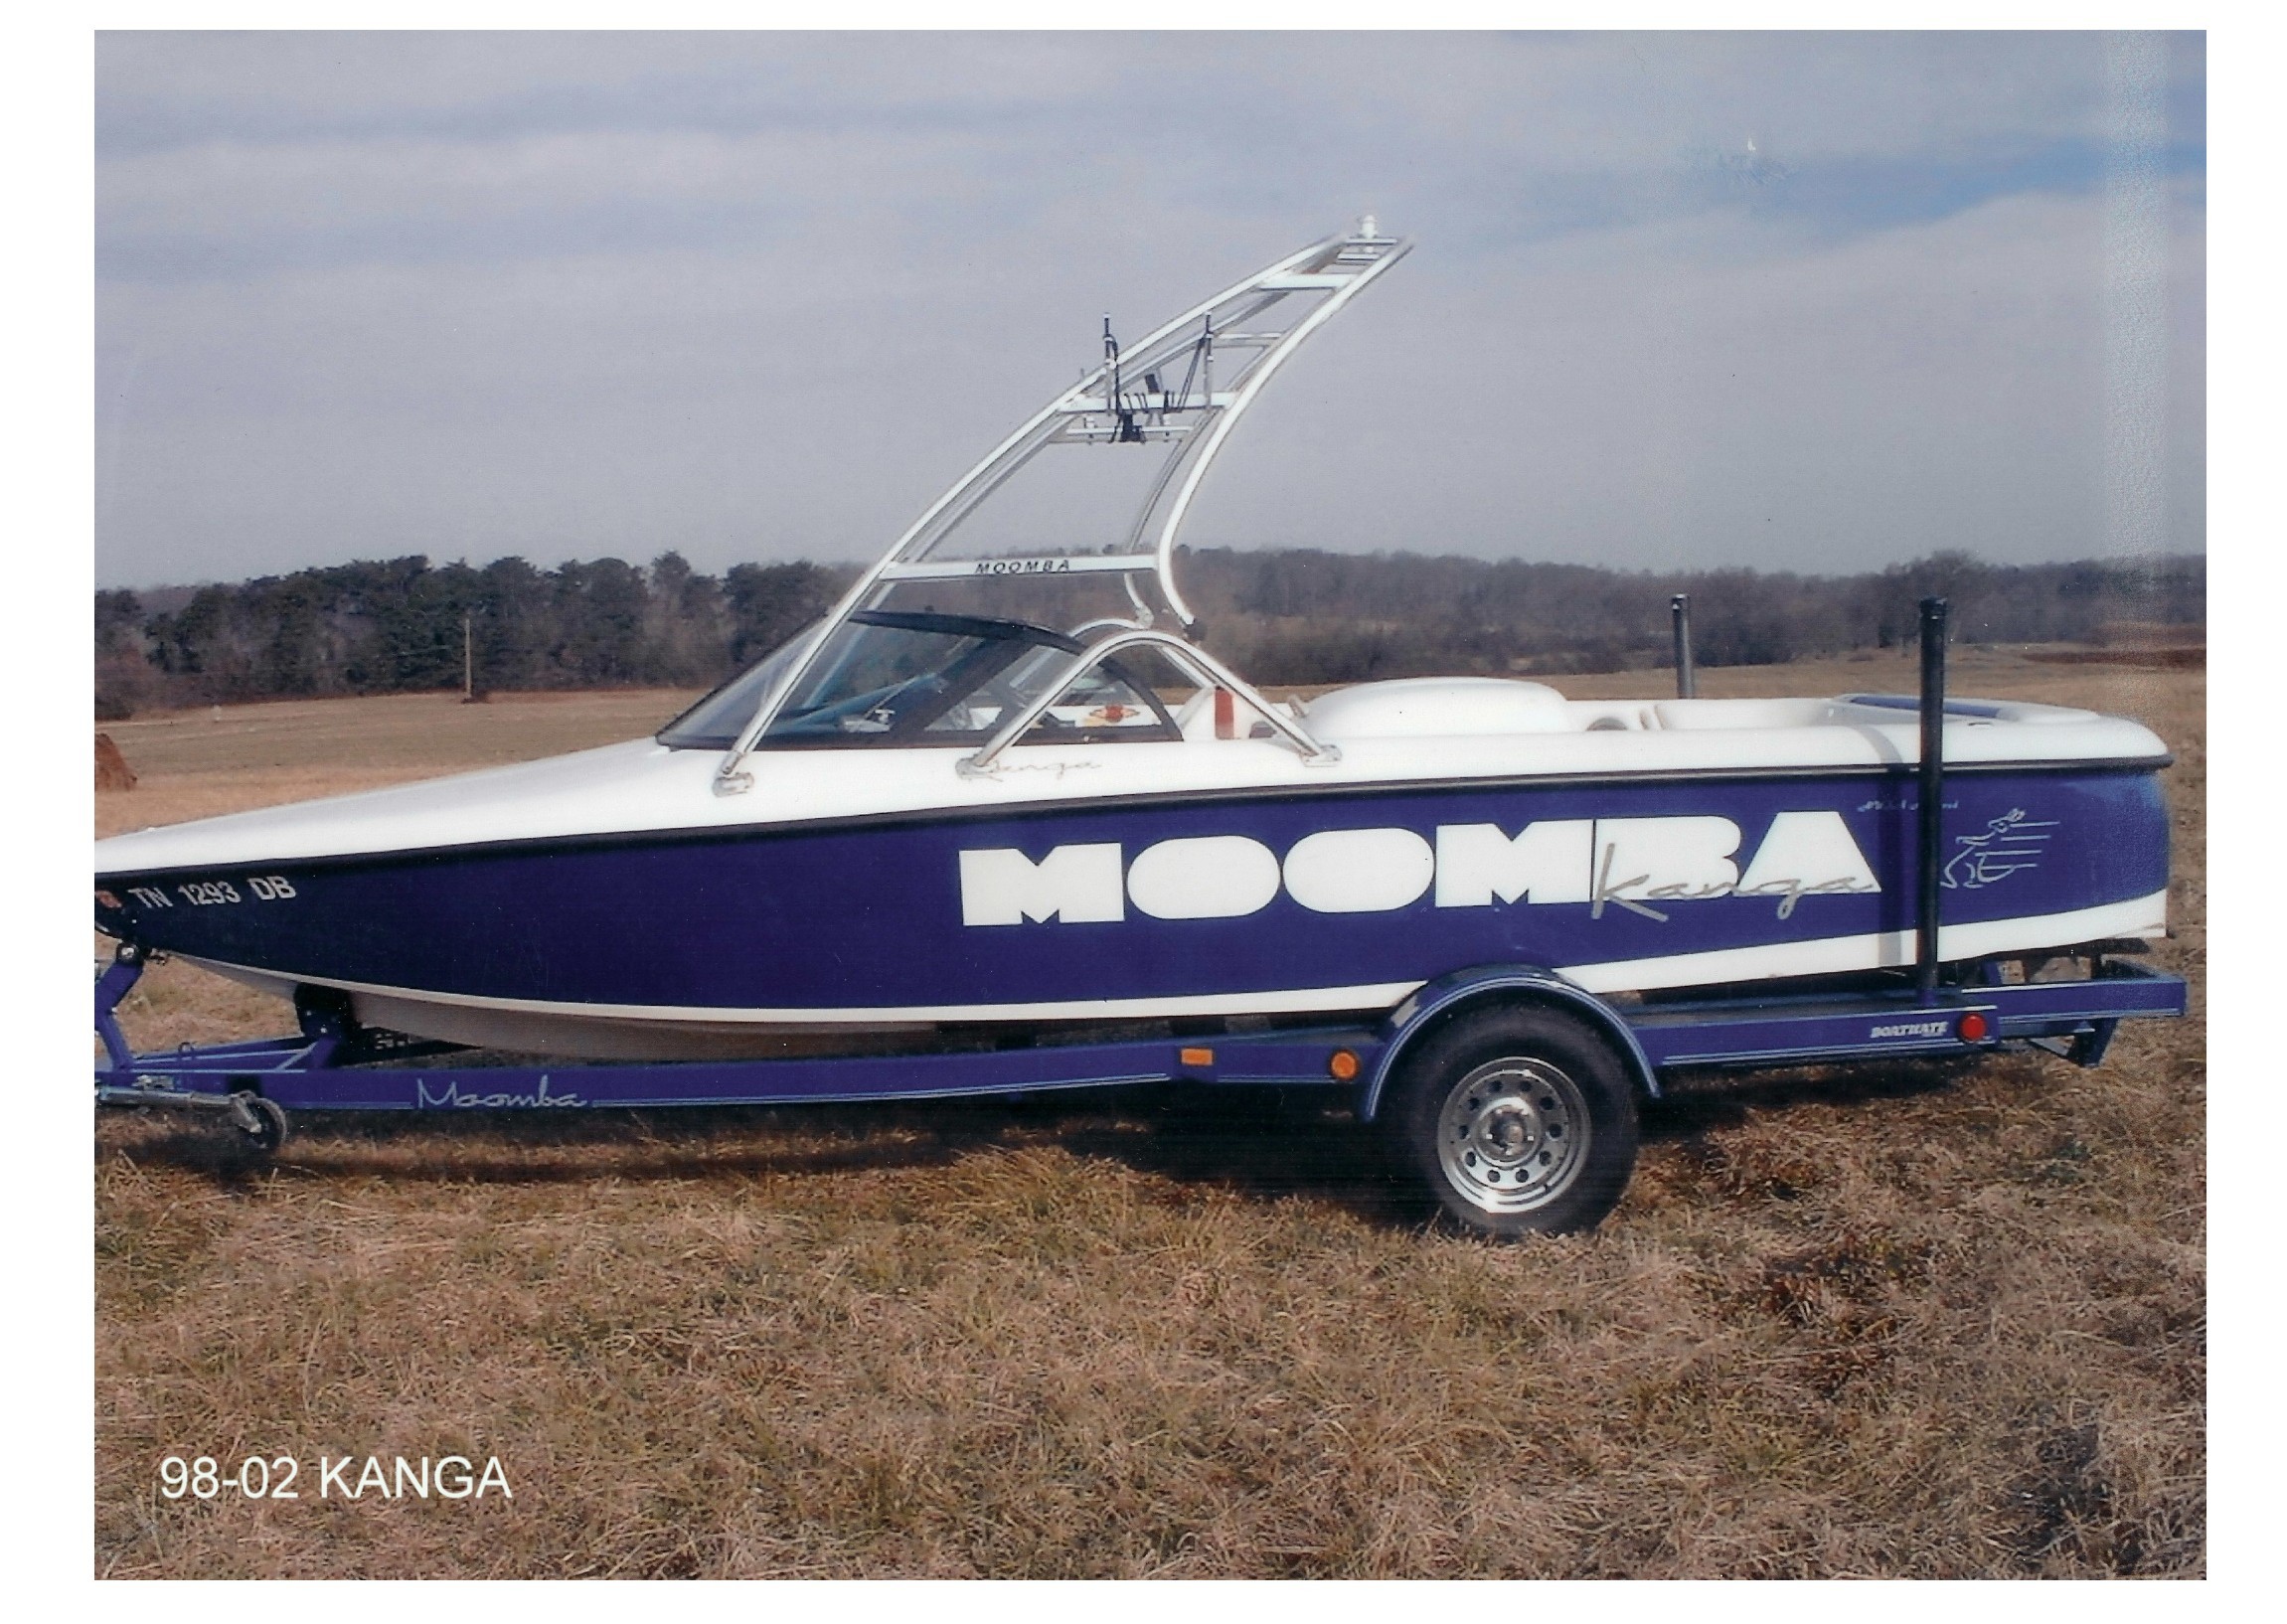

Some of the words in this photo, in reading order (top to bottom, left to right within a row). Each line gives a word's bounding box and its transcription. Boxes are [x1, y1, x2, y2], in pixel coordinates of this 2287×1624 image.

[975, 559, 1069, 574] MOOMBA
[959, 810, 1882, 926] MOOMBA
[1591, 843, 1875, 922] Kanga
[126, 887, 174, 908] TN
[178, 881, 242, 905] 1293
[246, 876, 297, 900] DB
[416, 1073, 588, 1109] Moomba
